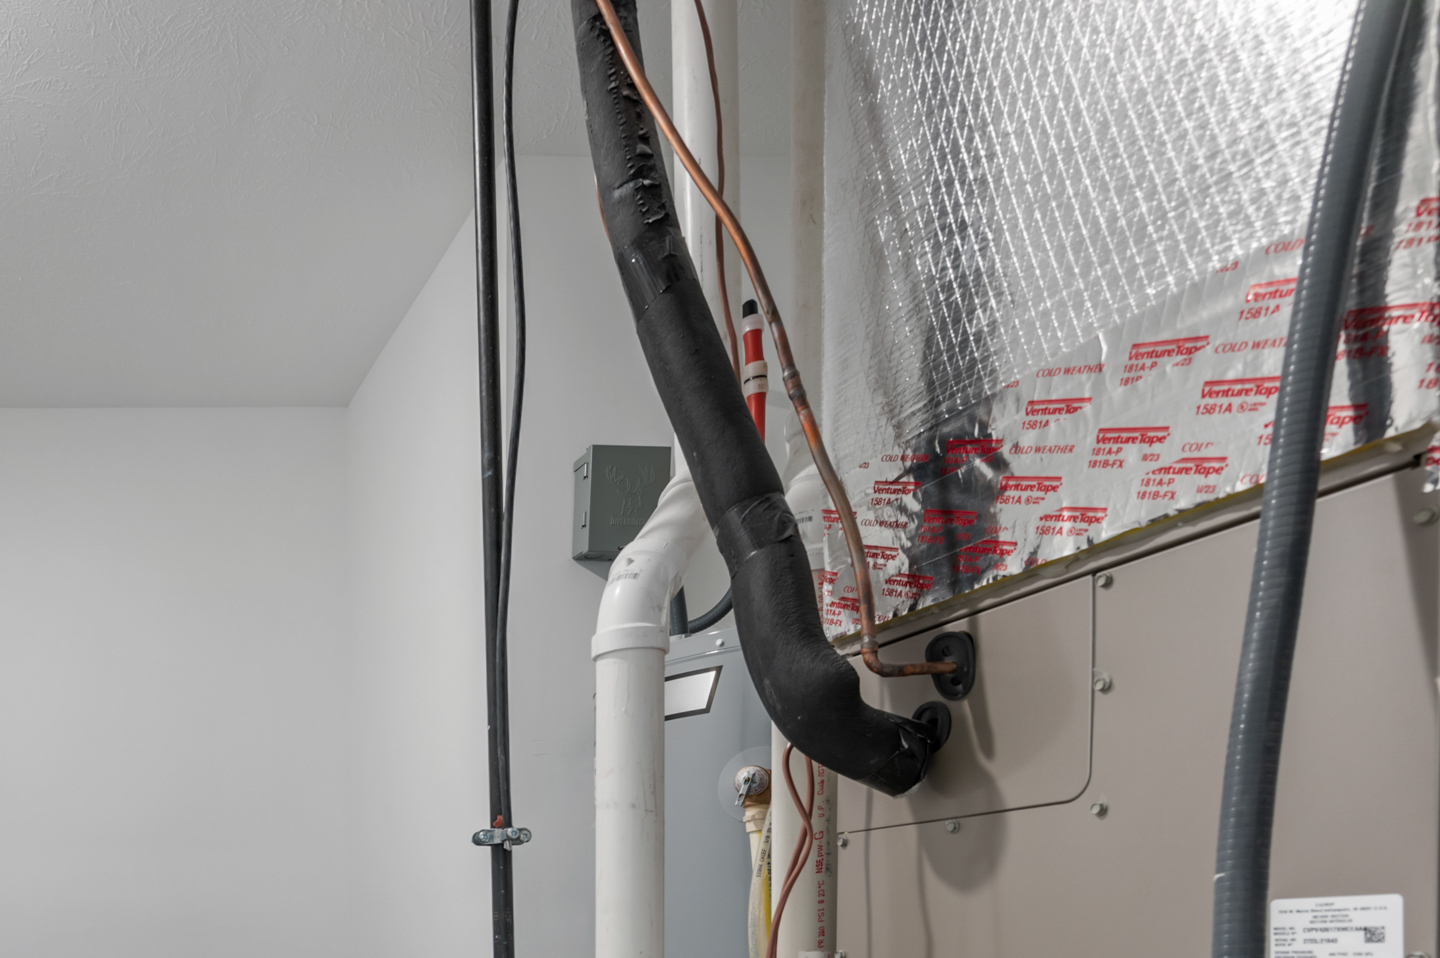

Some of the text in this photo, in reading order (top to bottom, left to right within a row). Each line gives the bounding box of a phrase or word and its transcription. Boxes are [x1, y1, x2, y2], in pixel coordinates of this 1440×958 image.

[1265, 238, 1304, 255] COLD
[1246, 288, 1296, 303] Ventur
[1215, 341, 1248, 354] COLD
[1036, 363, 1106, 378] COLD WEATHER
[1123, 362, 1157, 373] 181A-P
[1201, 384, 1280, 399] VentureTap
[1195, 402, 1232, 415] 1581A
[1096, 434, 1169, 447] VentureTape
[946, 445, 1003, 455] VentureTape
[1009, 444, 1075, 455] COLD WEATHER
[1091, 447, 1123, 456] 181A-P
[901, 454, 929, 462] WEATHER
[1088, 459, 1125, 469] 181B-FX
[1146, 463, 1228, 478] entureTape
[999, 482, 1062, 494] VentureTape
[1140, 478, 1175, 487] 181A-P
[995, 495, 1022, 505] 1581A
[1136, 491, 1177, 500] 181B-FX
[861, 519, 908, 529] COLD WEATHER
[923, 515, 977, 526] VentureTape
[920, 525, 943, 533] 181A-P
[1035, 526, 1063, 536] 1581A
[882, 588, 902, 598] 1581A
[817, 779, 825, 795] Code
